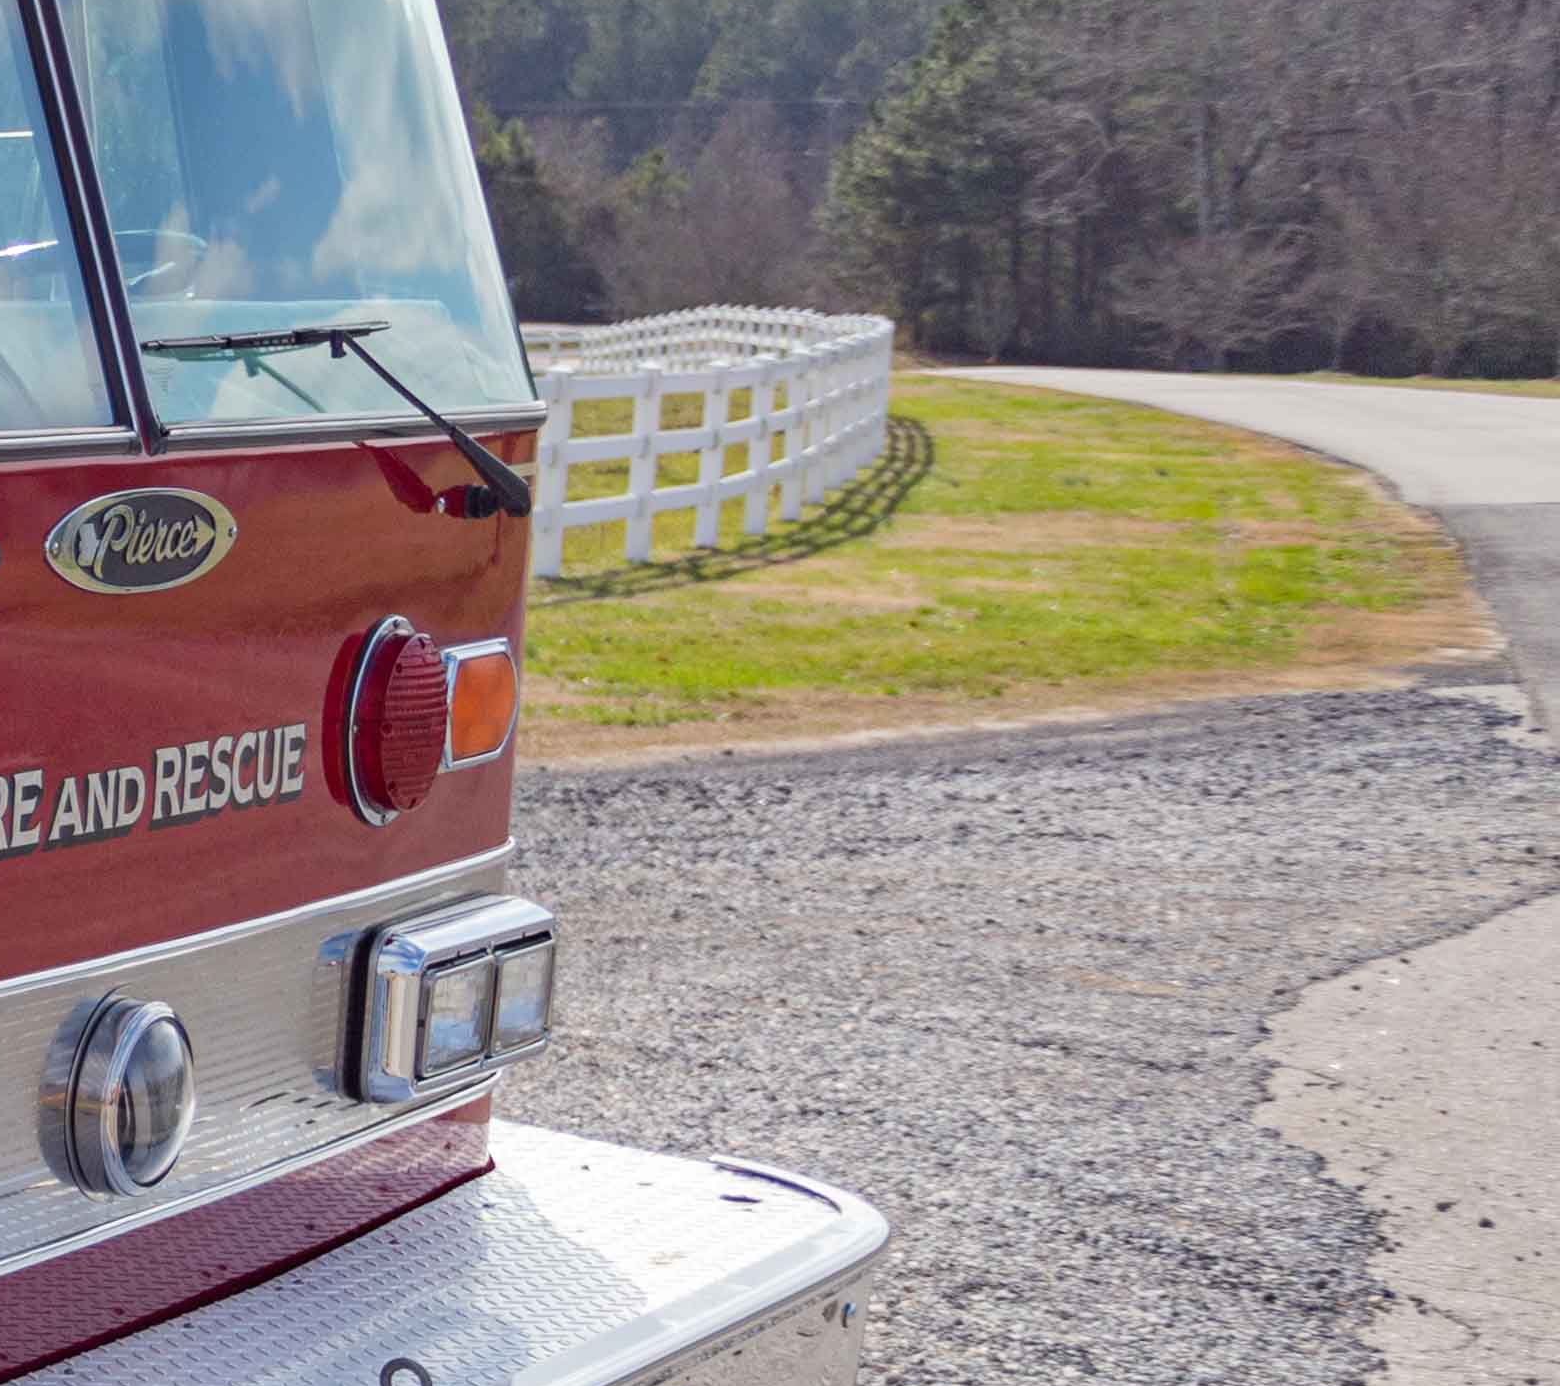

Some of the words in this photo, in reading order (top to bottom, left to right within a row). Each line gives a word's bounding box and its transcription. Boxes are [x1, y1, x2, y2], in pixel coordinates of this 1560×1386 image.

[93, 504, 196, 579] Pierce
[47, 765, 147, 842] AND
[151, 722, 307, 822] RESCUE
